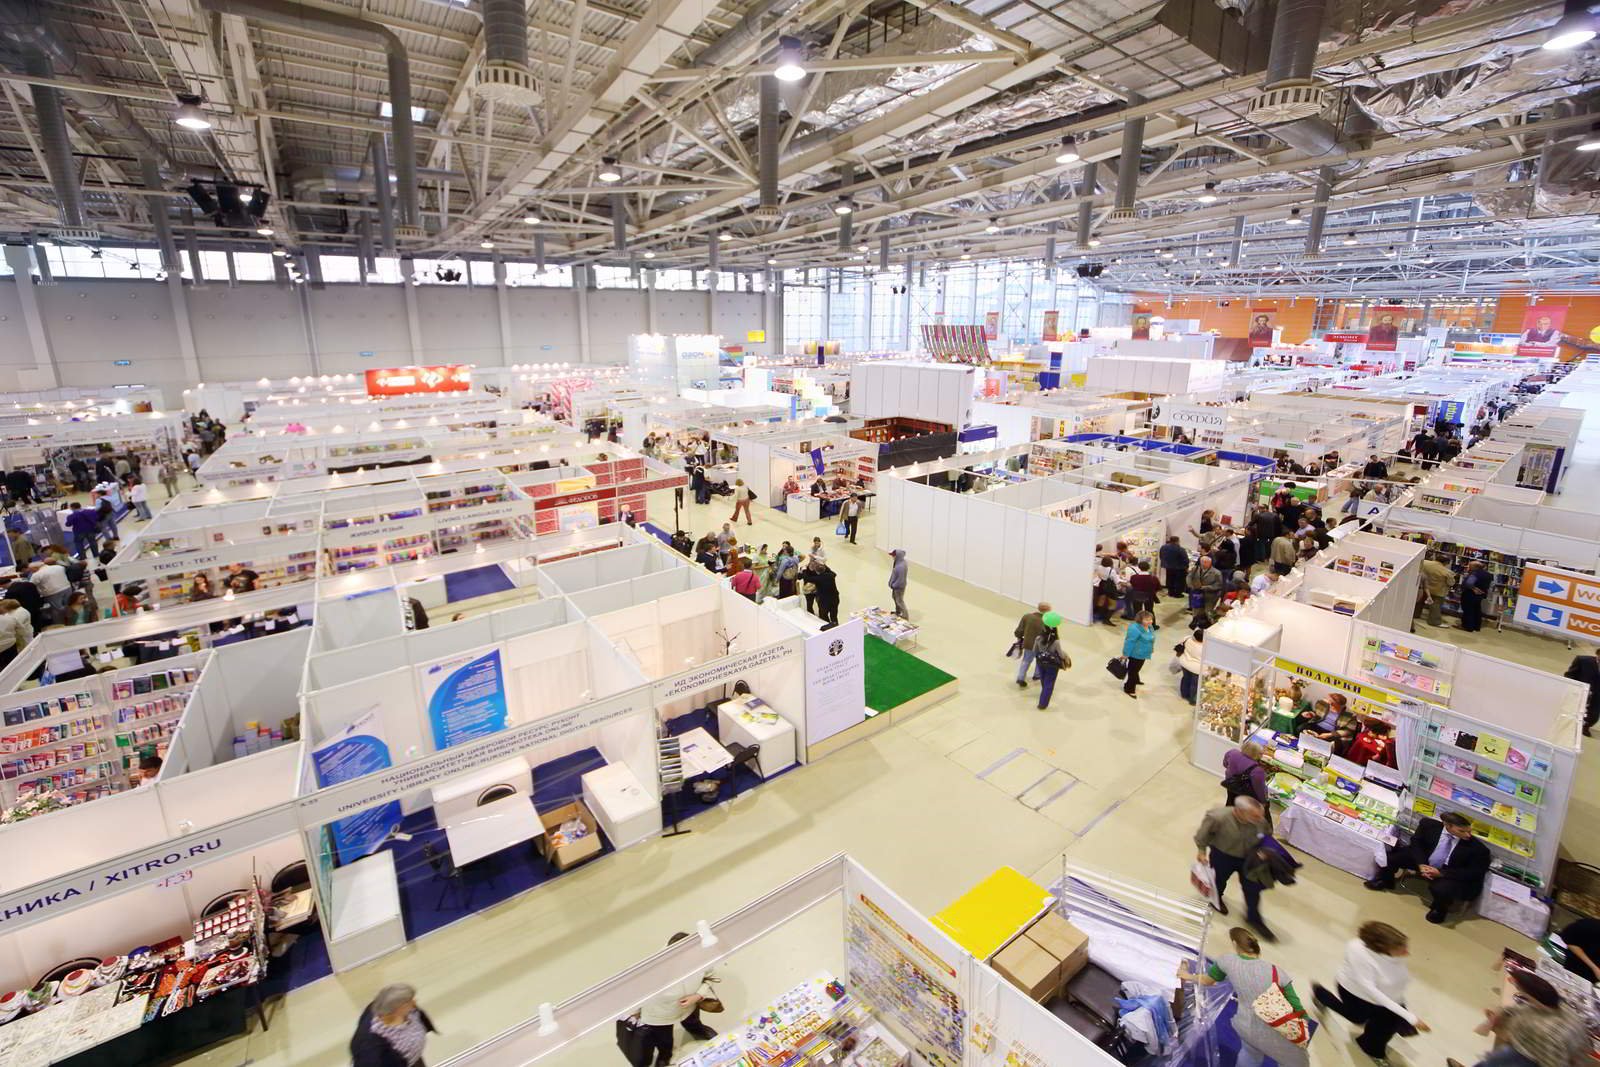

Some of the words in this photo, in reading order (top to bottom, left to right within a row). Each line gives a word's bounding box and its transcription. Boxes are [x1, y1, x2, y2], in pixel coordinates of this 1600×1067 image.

[152, 560, 184, 571] ТЕКСТ
[674, 679, 687, 688] ИД
[688, 654, 758, 683] ЭКОНОМИЧЕСКАЯ
[759, 645, 785, 659] ГАЗЕТА
[1296, 666, 1362, 694] ПОДАРКИ
[338, 788, 397, 812] UNIVERSITY
[401, 774, 441, 791] LIBRARY
[520, 734, 557, 750] NATIONAL
[560, 723, 588, 736] DIGITAL
[381, 752, 465, 784] НАЦИОНАЛЬНЫЙ
[518, 723, 550, 738] РЕСУРС
[393, 751, 486, 785] УНИВЕРСИТЕТСКАЯ
[487, 731, 543, 753] БИБЛИОТЕКА
[105, 838, 222, 886] XITRO.RU
